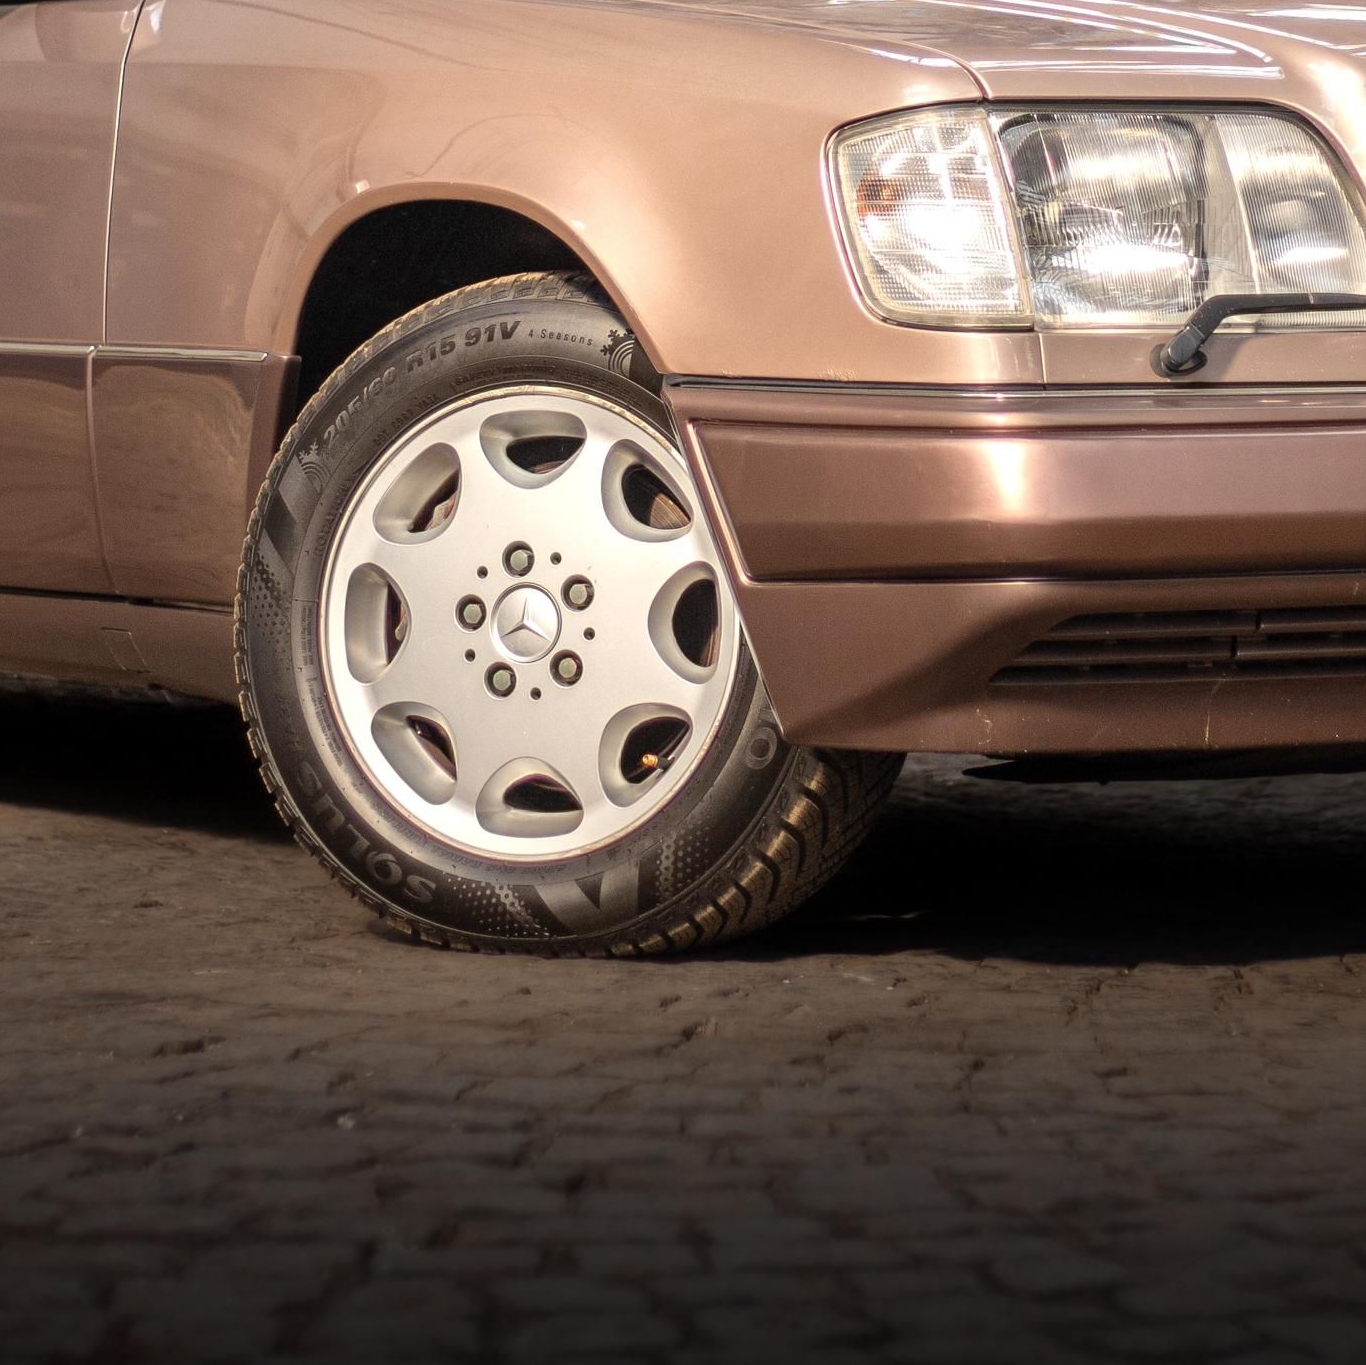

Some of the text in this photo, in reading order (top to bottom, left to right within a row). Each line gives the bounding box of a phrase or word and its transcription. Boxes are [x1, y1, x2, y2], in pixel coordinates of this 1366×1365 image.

[322, 366, 399, 445] 205/60
[403, 337, 458, 373] R15
[464, 320, 521, 347] 91V
[540, 328, 594, 347] Seasons
[297, 762, 435, 905] SOLUS
